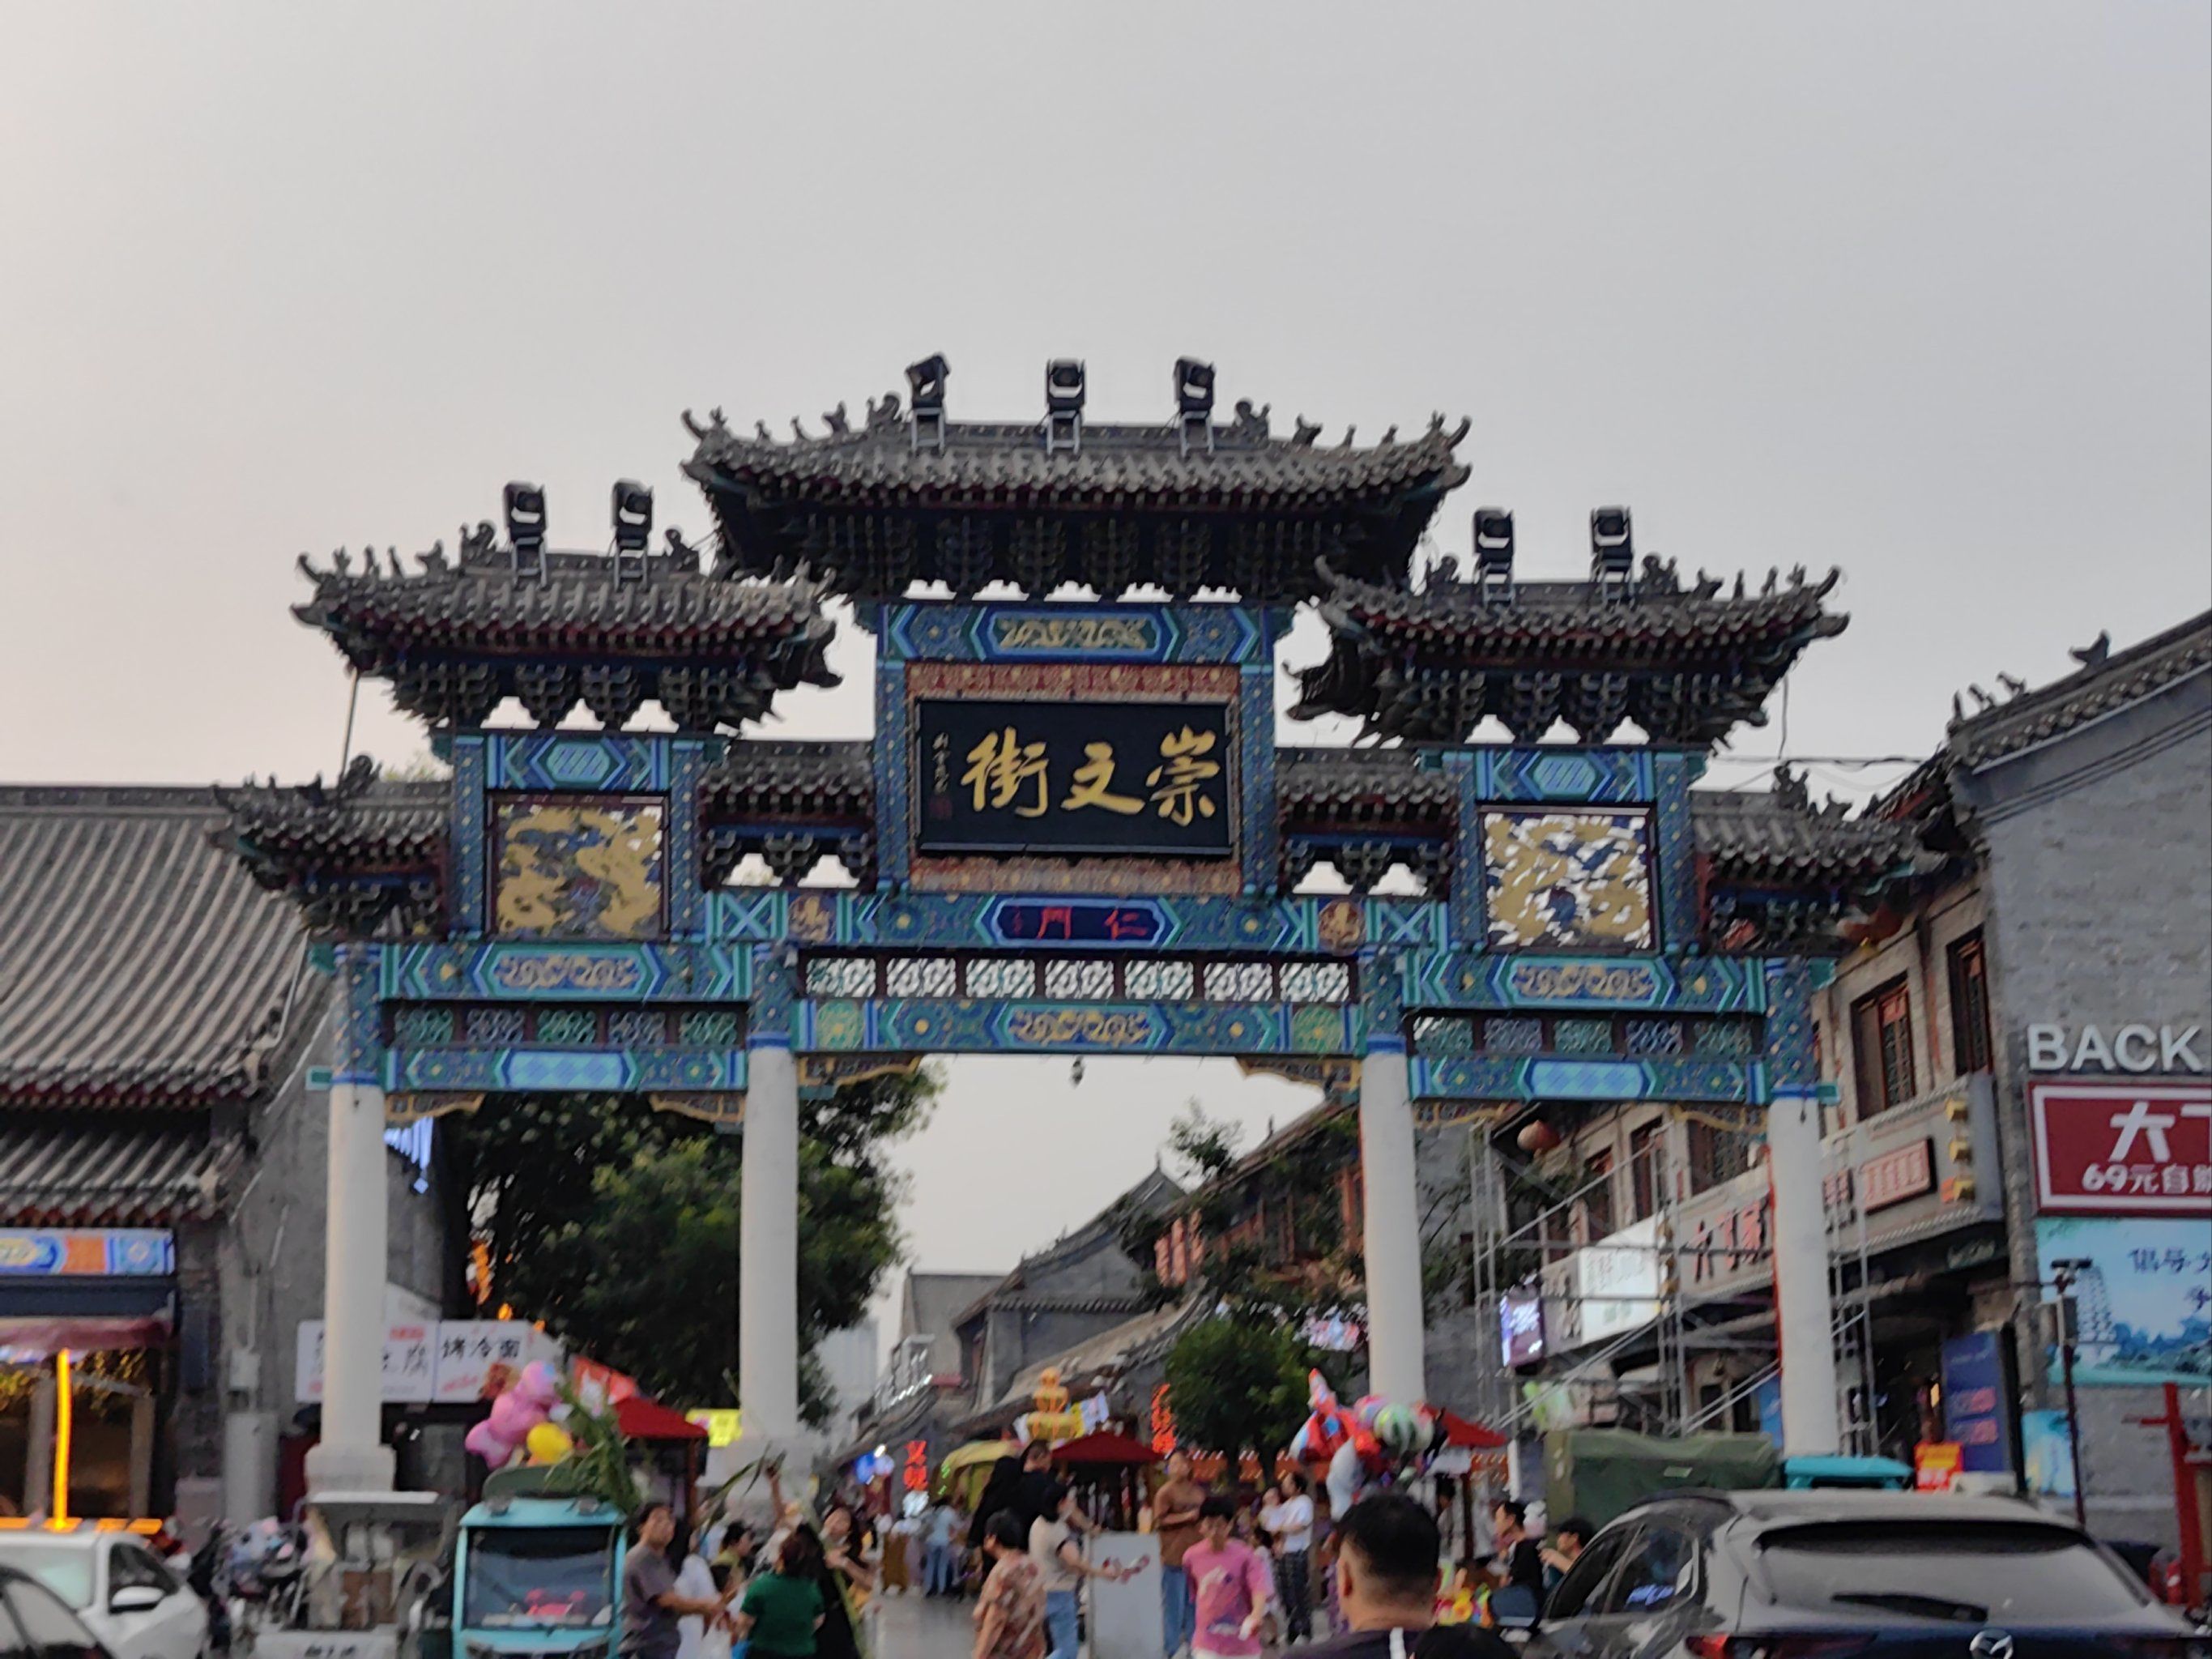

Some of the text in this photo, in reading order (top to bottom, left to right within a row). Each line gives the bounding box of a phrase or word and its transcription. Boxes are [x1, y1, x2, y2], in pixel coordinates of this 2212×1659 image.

[961, 725, 1220, 826] 崇文街
[2027, 1023, 2203, 1073] BACK
